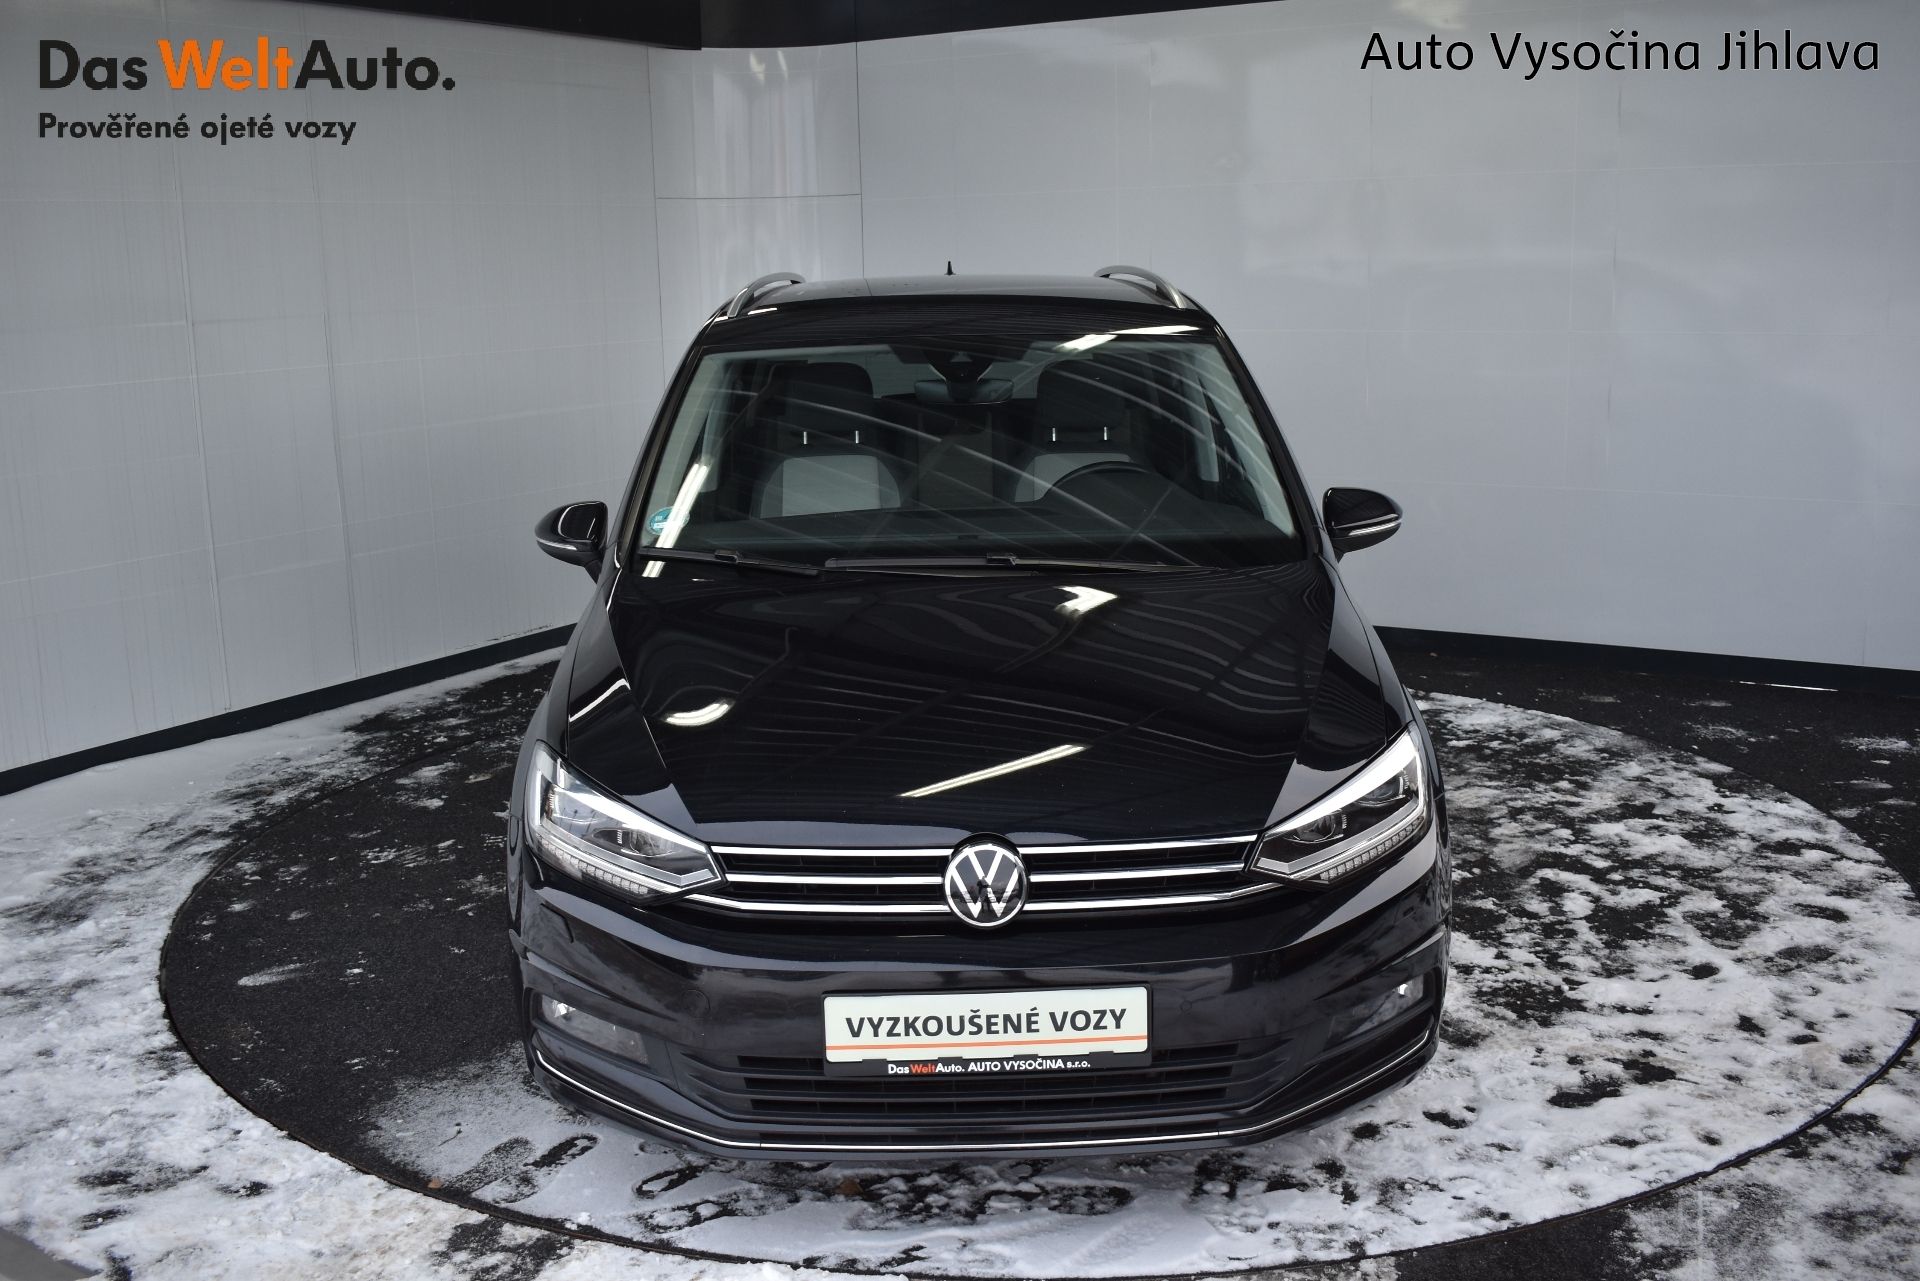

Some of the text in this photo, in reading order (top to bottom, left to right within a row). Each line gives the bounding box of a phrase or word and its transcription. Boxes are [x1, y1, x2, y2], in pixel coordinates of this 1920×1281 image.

[845, 1006, 1127, 1038] VYZKOUŠENÉ VOZY
[968, 1060, 1001, 1072] AUTO
[1003, 1056, 1065, 1071] VYSOČINA
[1066, 1058, 1091, 1068] s.r.o.
